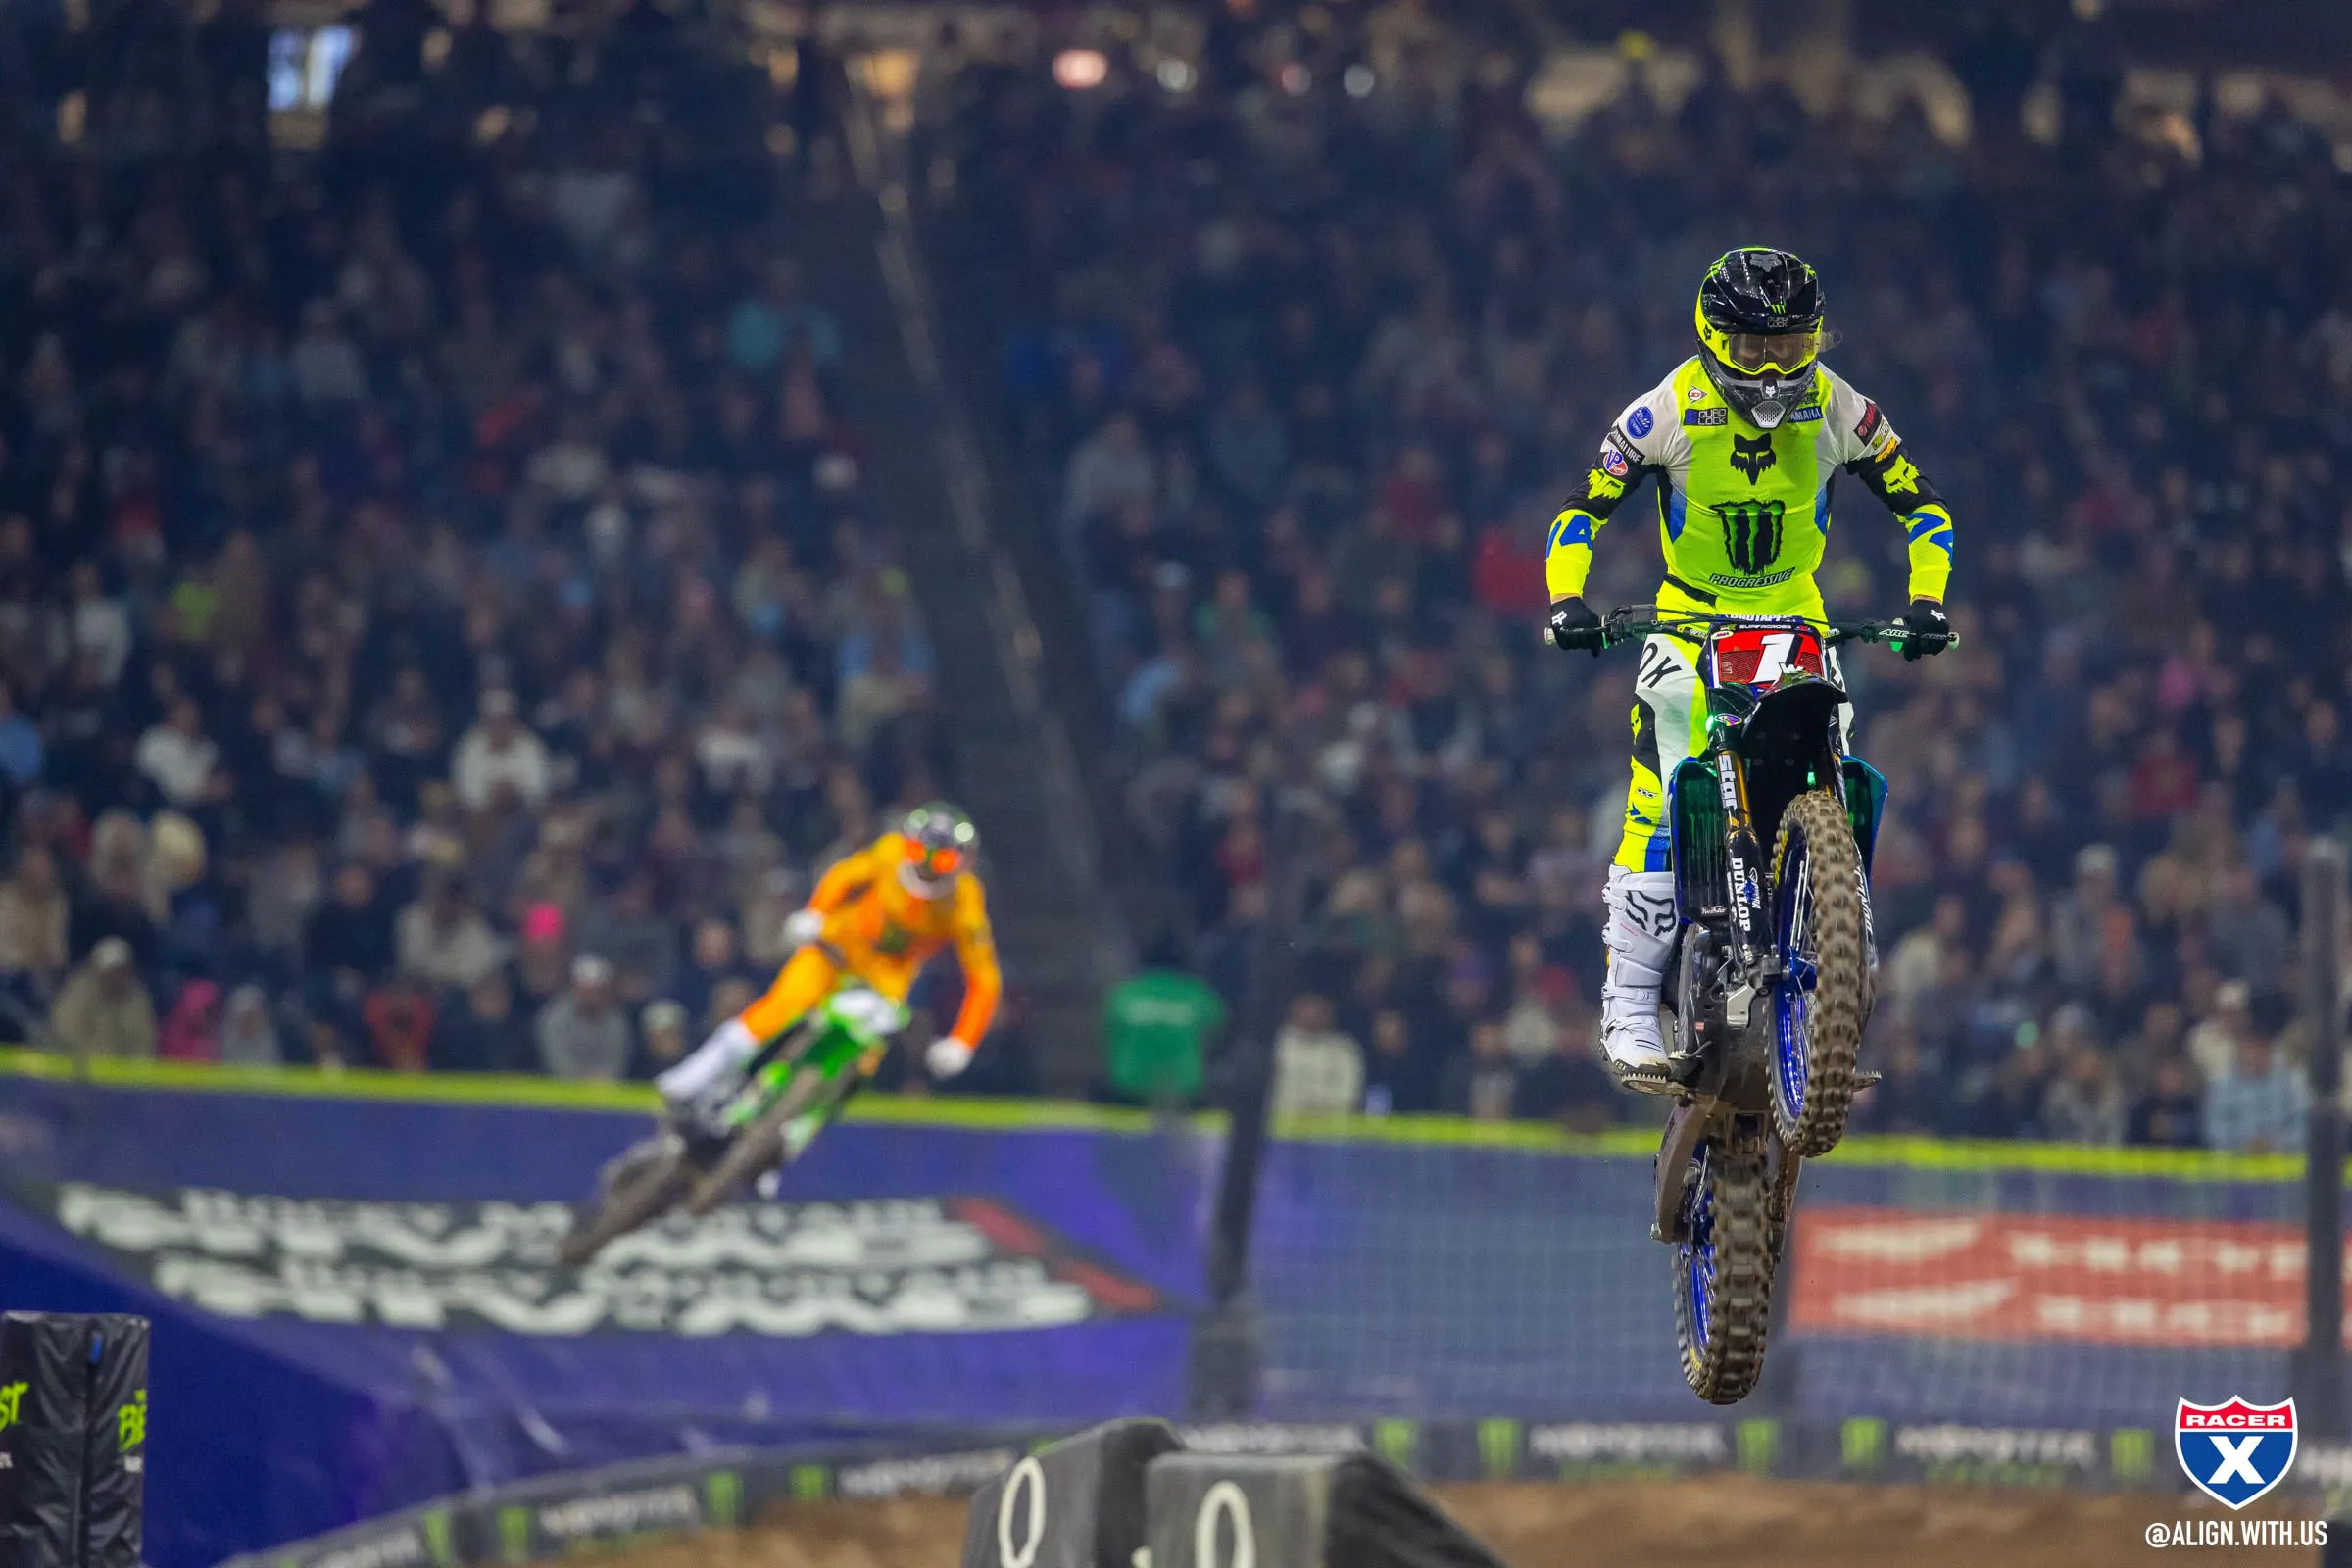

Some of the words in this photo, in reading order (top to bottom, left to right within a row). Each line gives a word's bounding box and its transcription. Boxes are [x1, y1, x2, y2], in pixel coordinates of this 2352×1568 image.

[1697, 416, 1726, 425] LOCK
[1698, 409, 1727, 417] QUAD
[1790, 407, 1822, 421] AMAHA
[1710, 568, 1792, 588] PROGRESSIVE
[1639, 642, 1683, 688] OX
[1749, 633, 1796, 684] 1
[1731, 857, 1751, 932] DUNLOP
